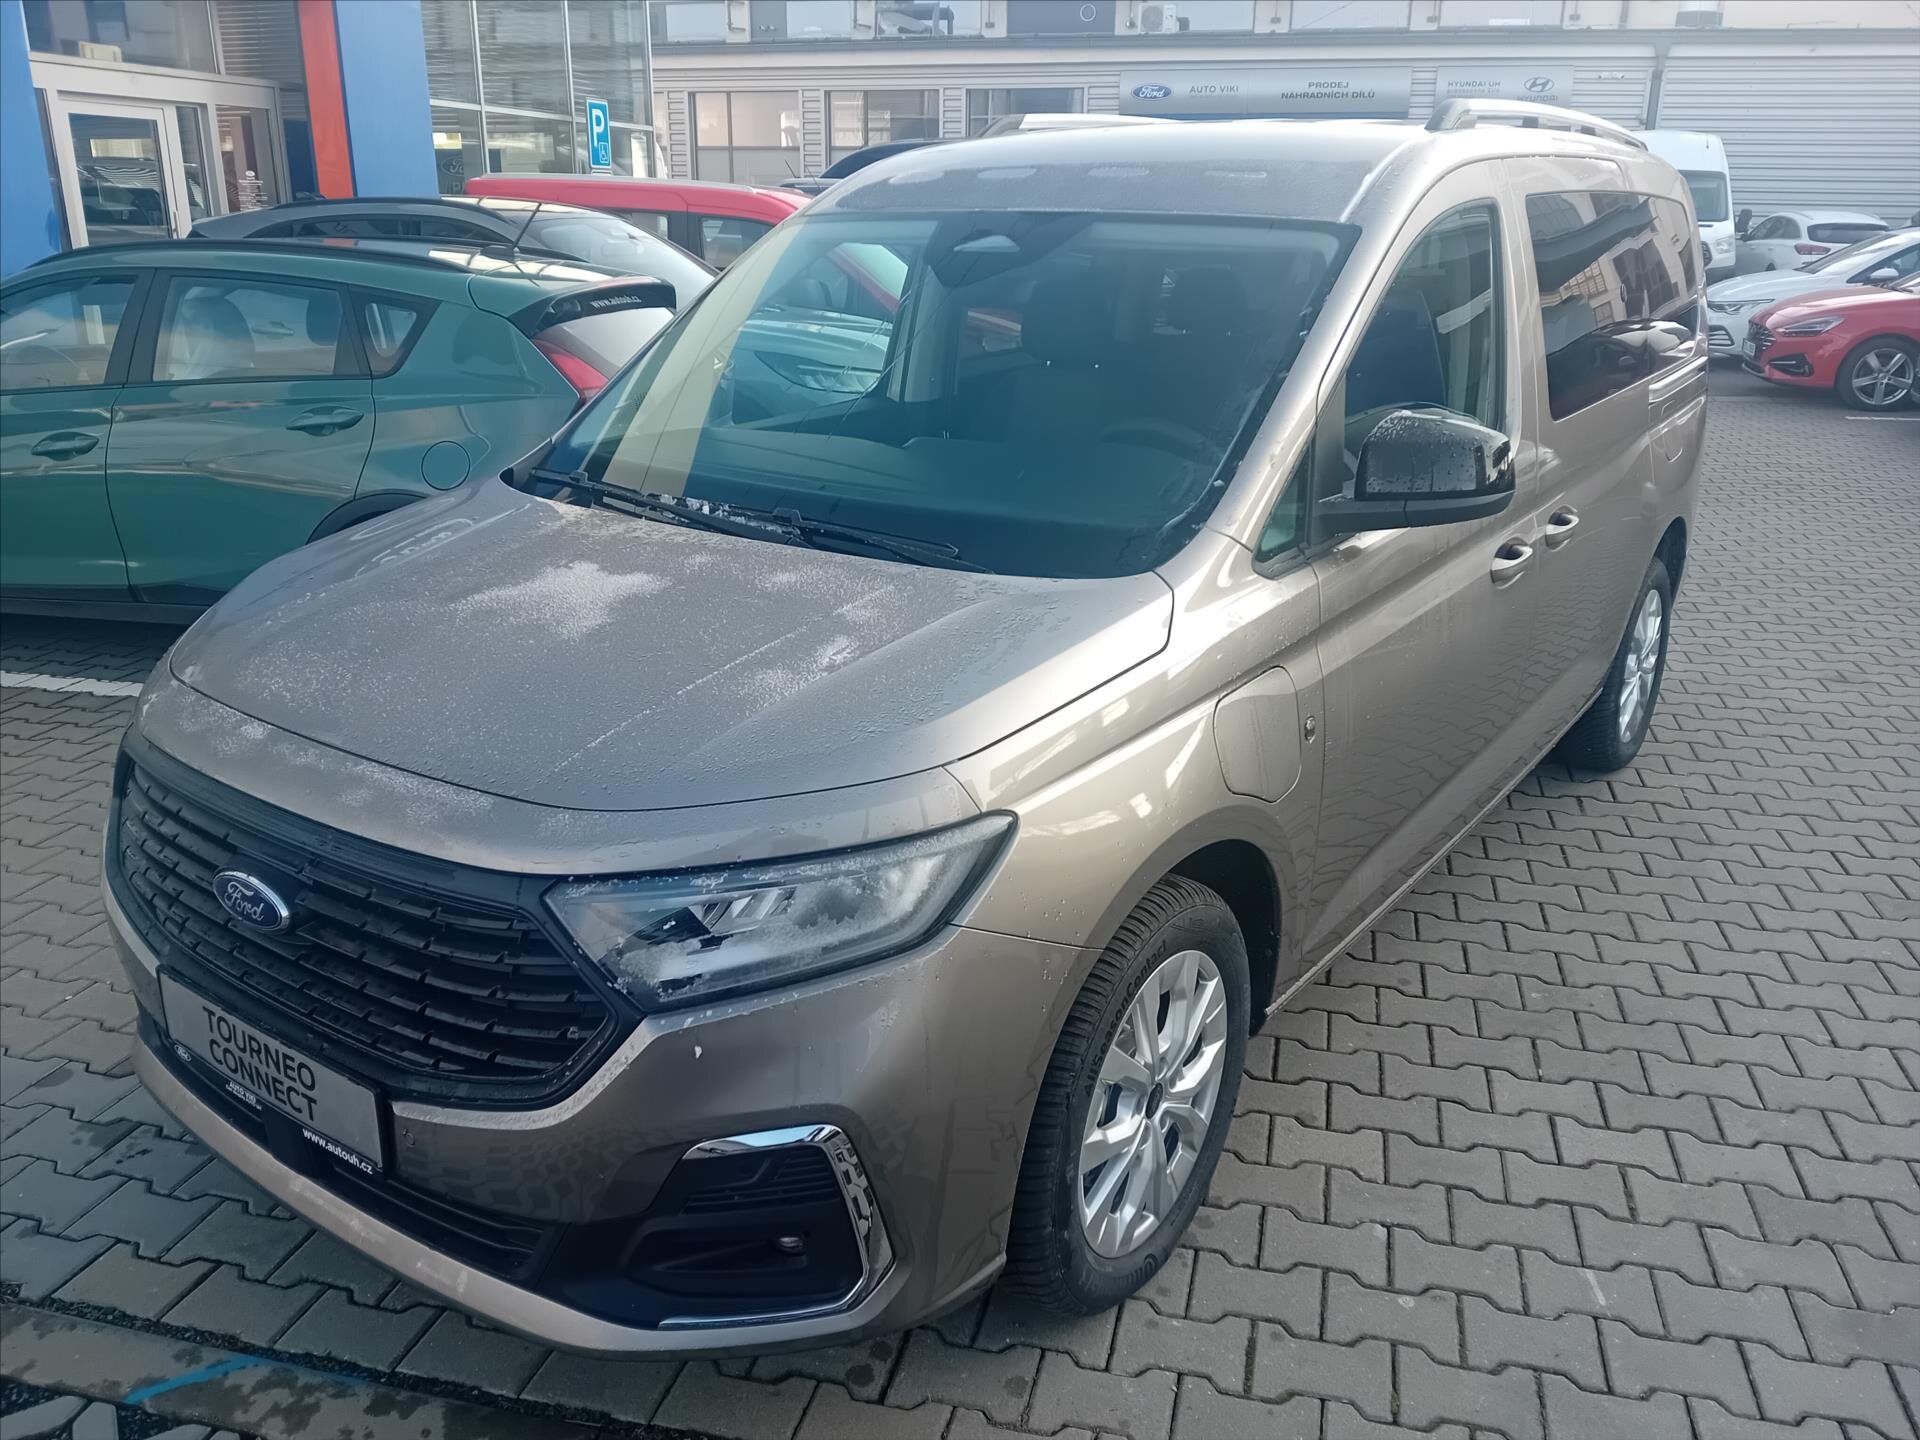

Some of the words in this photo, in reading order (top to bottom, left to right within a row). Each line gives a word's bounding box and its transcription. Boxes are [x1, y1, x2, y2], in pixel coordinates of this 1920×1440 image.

[1136, 84, 1168, 99] Ford
[1189, 85, 1216, 94] AUTO
[1219, 85, 1239, 93] VIKI
[1308, 81, 1349, 89] PRODEJ
[1447, 80, 1486, 88] HYUNDAI
[591, 108, 605, 147] P
[224, 881, 265, 921] Ford
[202, 1006, 316, 1092] TOURNEO
[209, 1038, 317, 1121] CONNECT
[302, 1128, 374, 1175] www.autouh.cz
